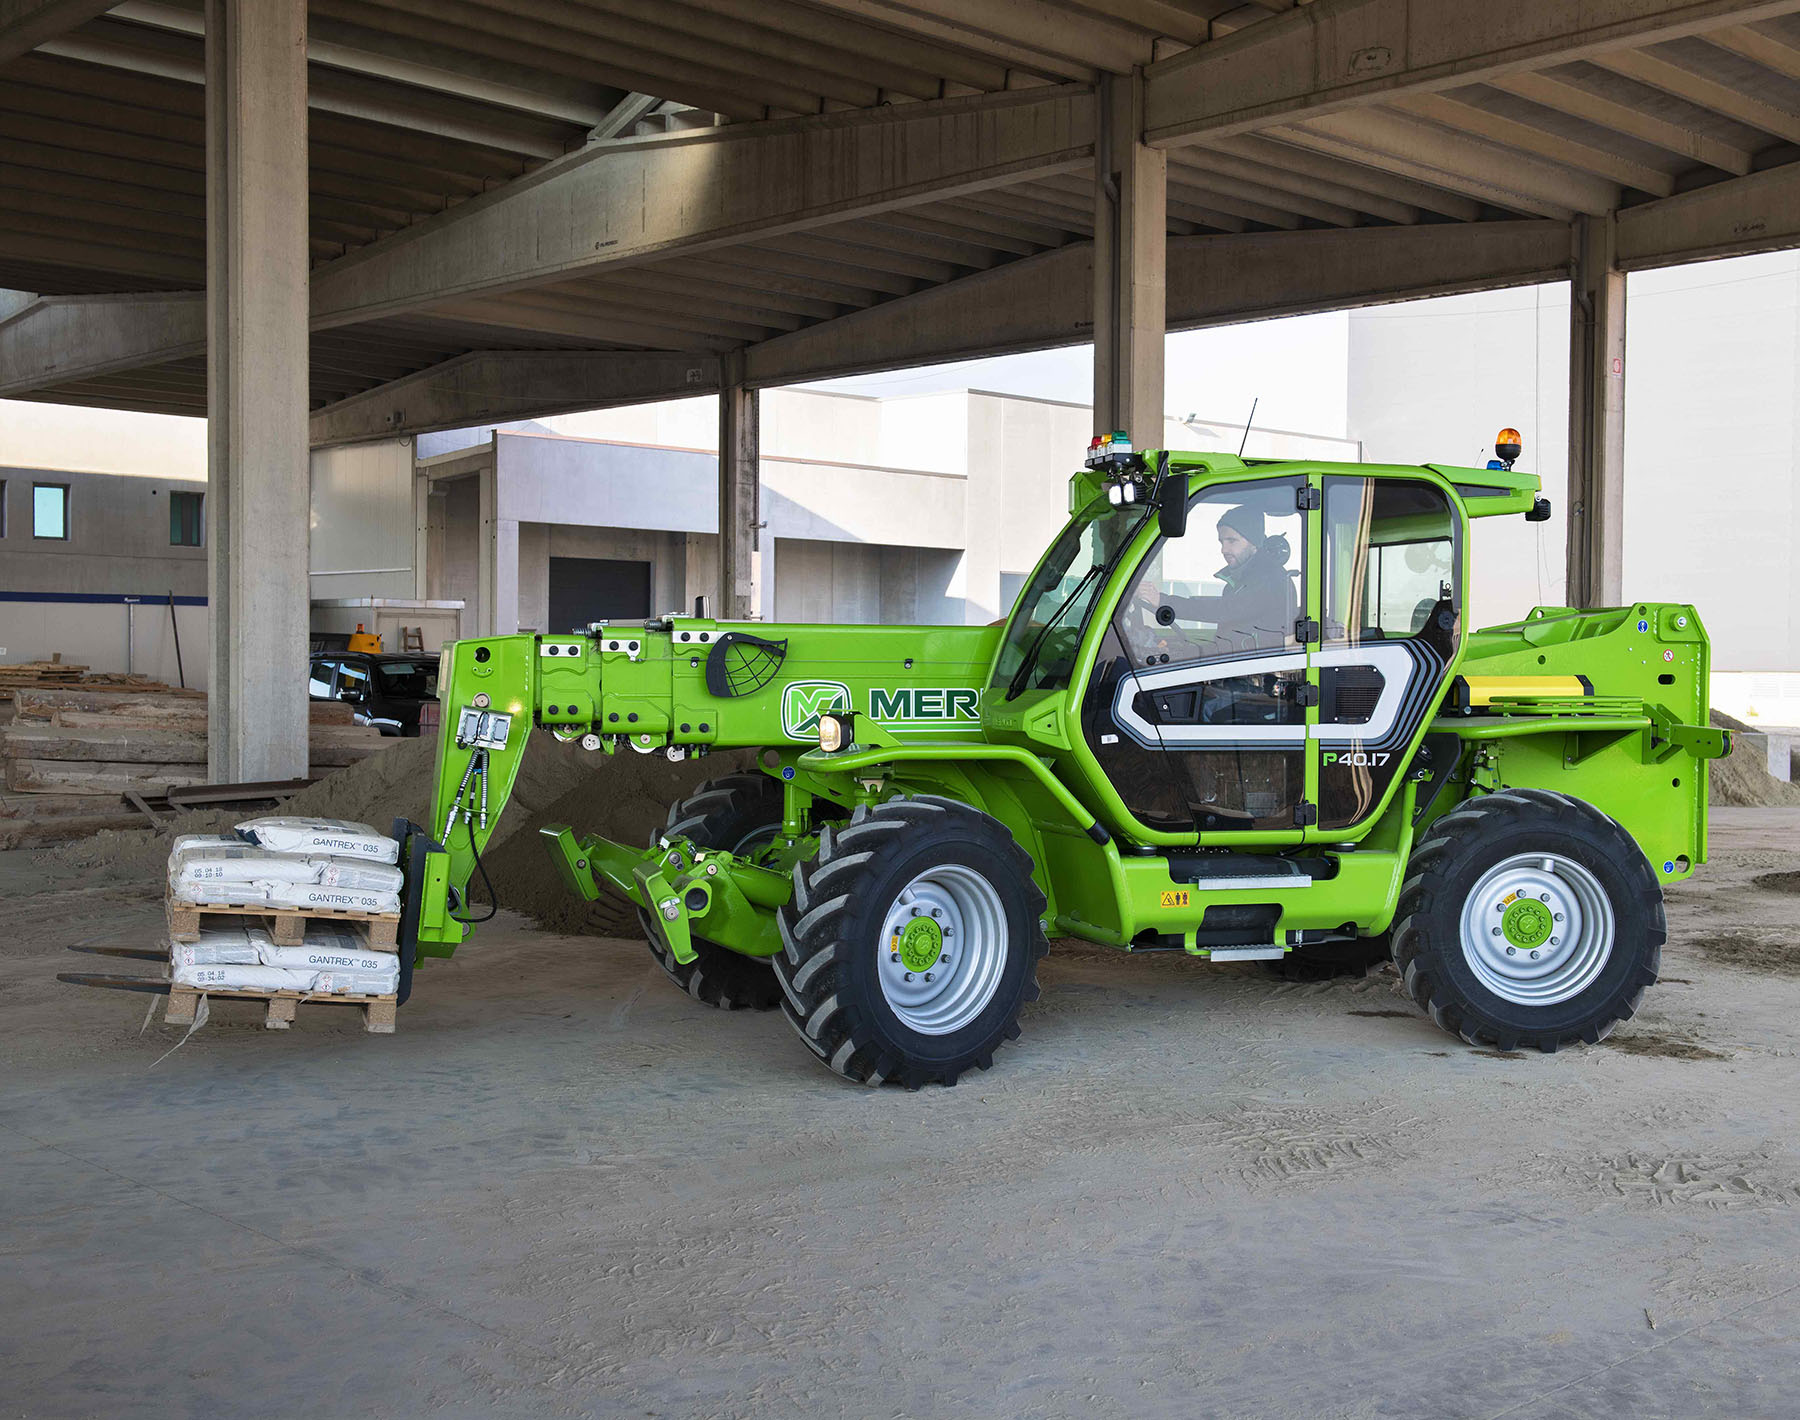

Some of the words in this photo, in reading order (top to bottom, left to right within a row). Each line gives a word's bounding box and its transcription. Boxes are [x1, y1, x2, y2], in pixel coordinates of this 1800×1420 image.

[869, 688, 983, 720] MER
[1322, 752, 1391, 767] P40.17
[363, 843, 379, 853] 035
[361, 897, 378, 906] 035
[361, 959, 378, 969] 035
